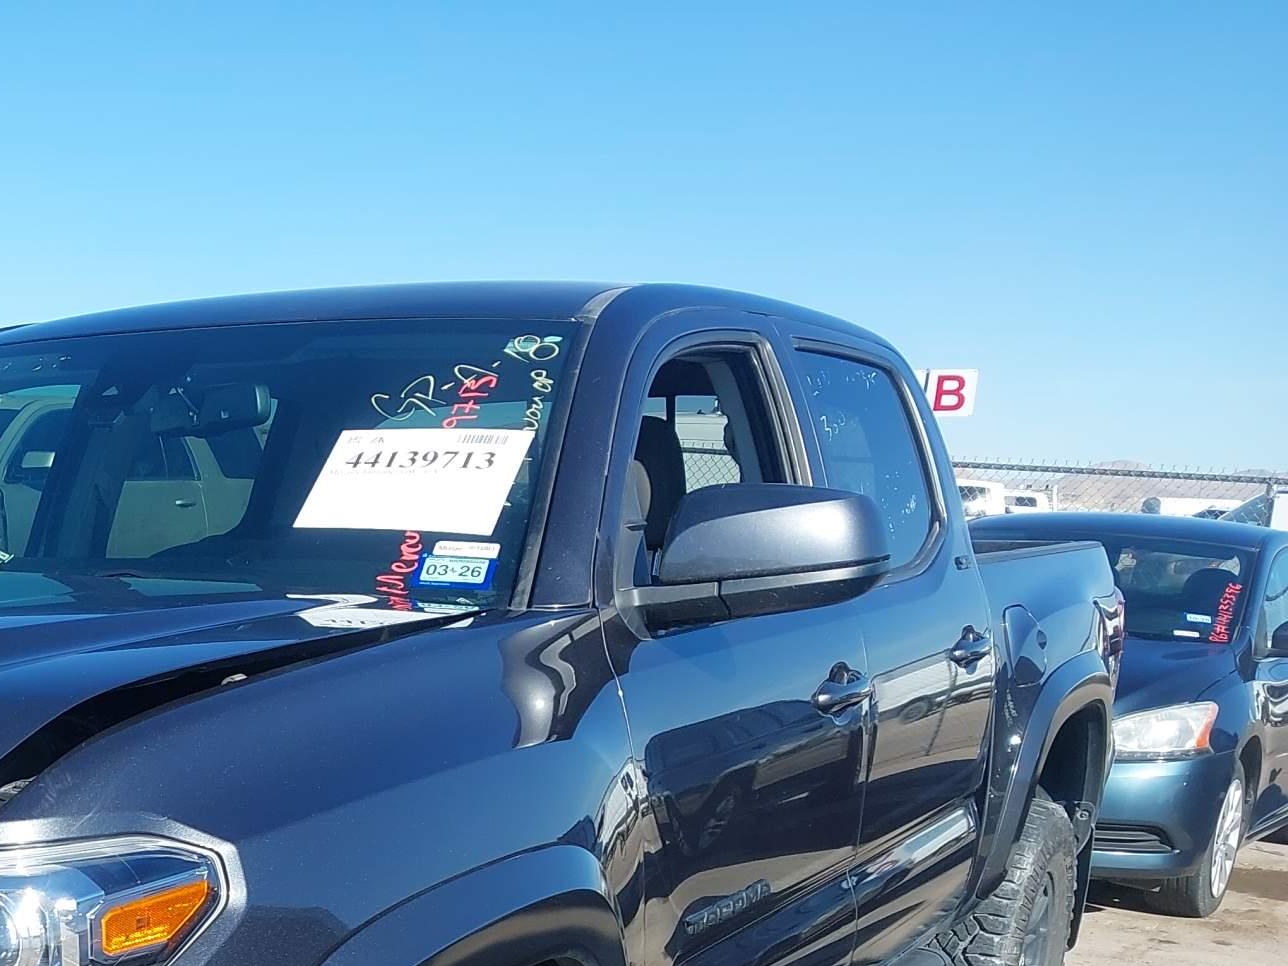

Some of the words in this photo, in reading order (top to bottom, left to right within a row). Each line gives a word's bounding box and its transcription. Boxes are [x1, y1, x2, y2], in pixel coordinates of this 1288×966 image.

[933, 375, 965, 411] B
[345, 451, 496, 470] 44139713
[425, 564, 449, 577] 03
[458, 565, 483, 578] 26
[684, 879, 771, 936] TACOMA
